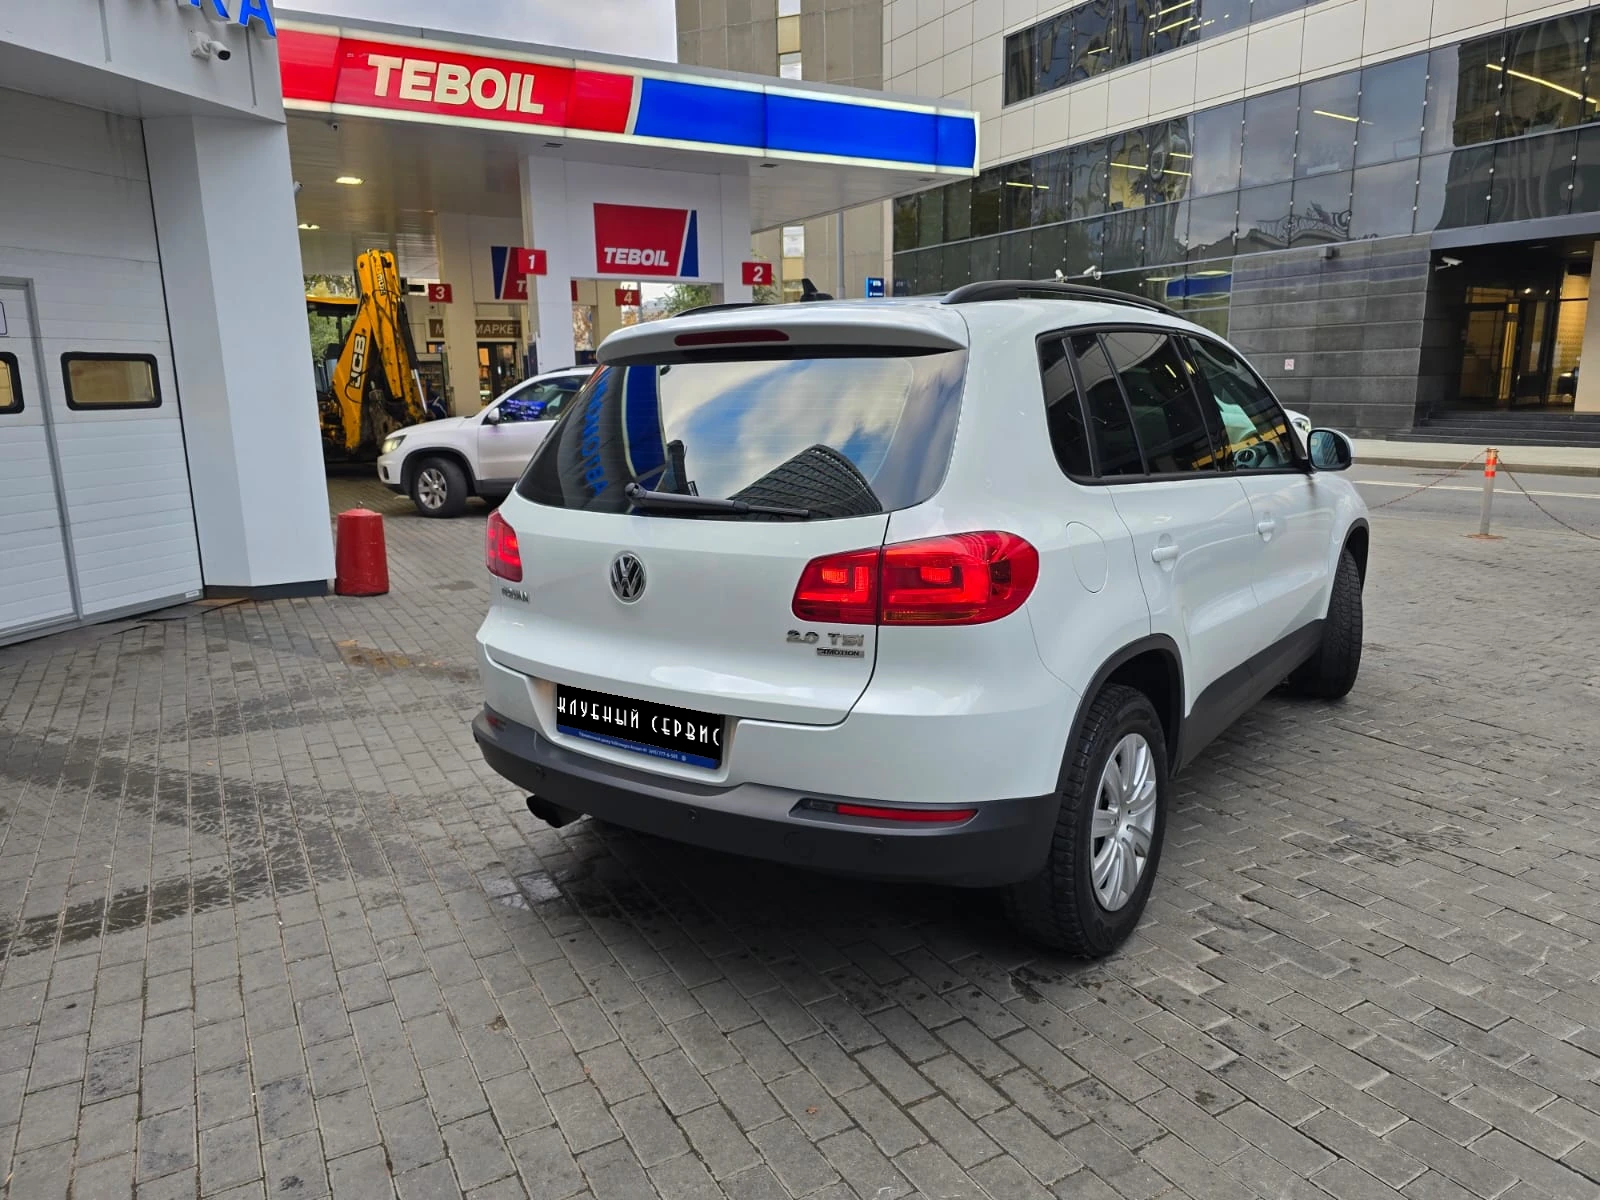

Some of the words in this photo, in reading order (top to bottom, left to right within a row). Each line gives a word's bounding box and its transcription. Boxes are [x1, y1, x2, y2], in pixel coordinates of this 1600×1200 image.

[367, 53, 544, 114] TEBOIL
[528, 254, 536, 270] 1
[603, 247, 670, 267] TEBOIL
[752, 265, 764, 282] 2
[435, 286, 445, 300] 3
[516, 279, 528, 293] T
[623, 291, 633, 304] 4
[350, 333, 367, 388] JCB
[786, 629, 819, 644] 2.0
[828, 632, 865, 646] TSI
